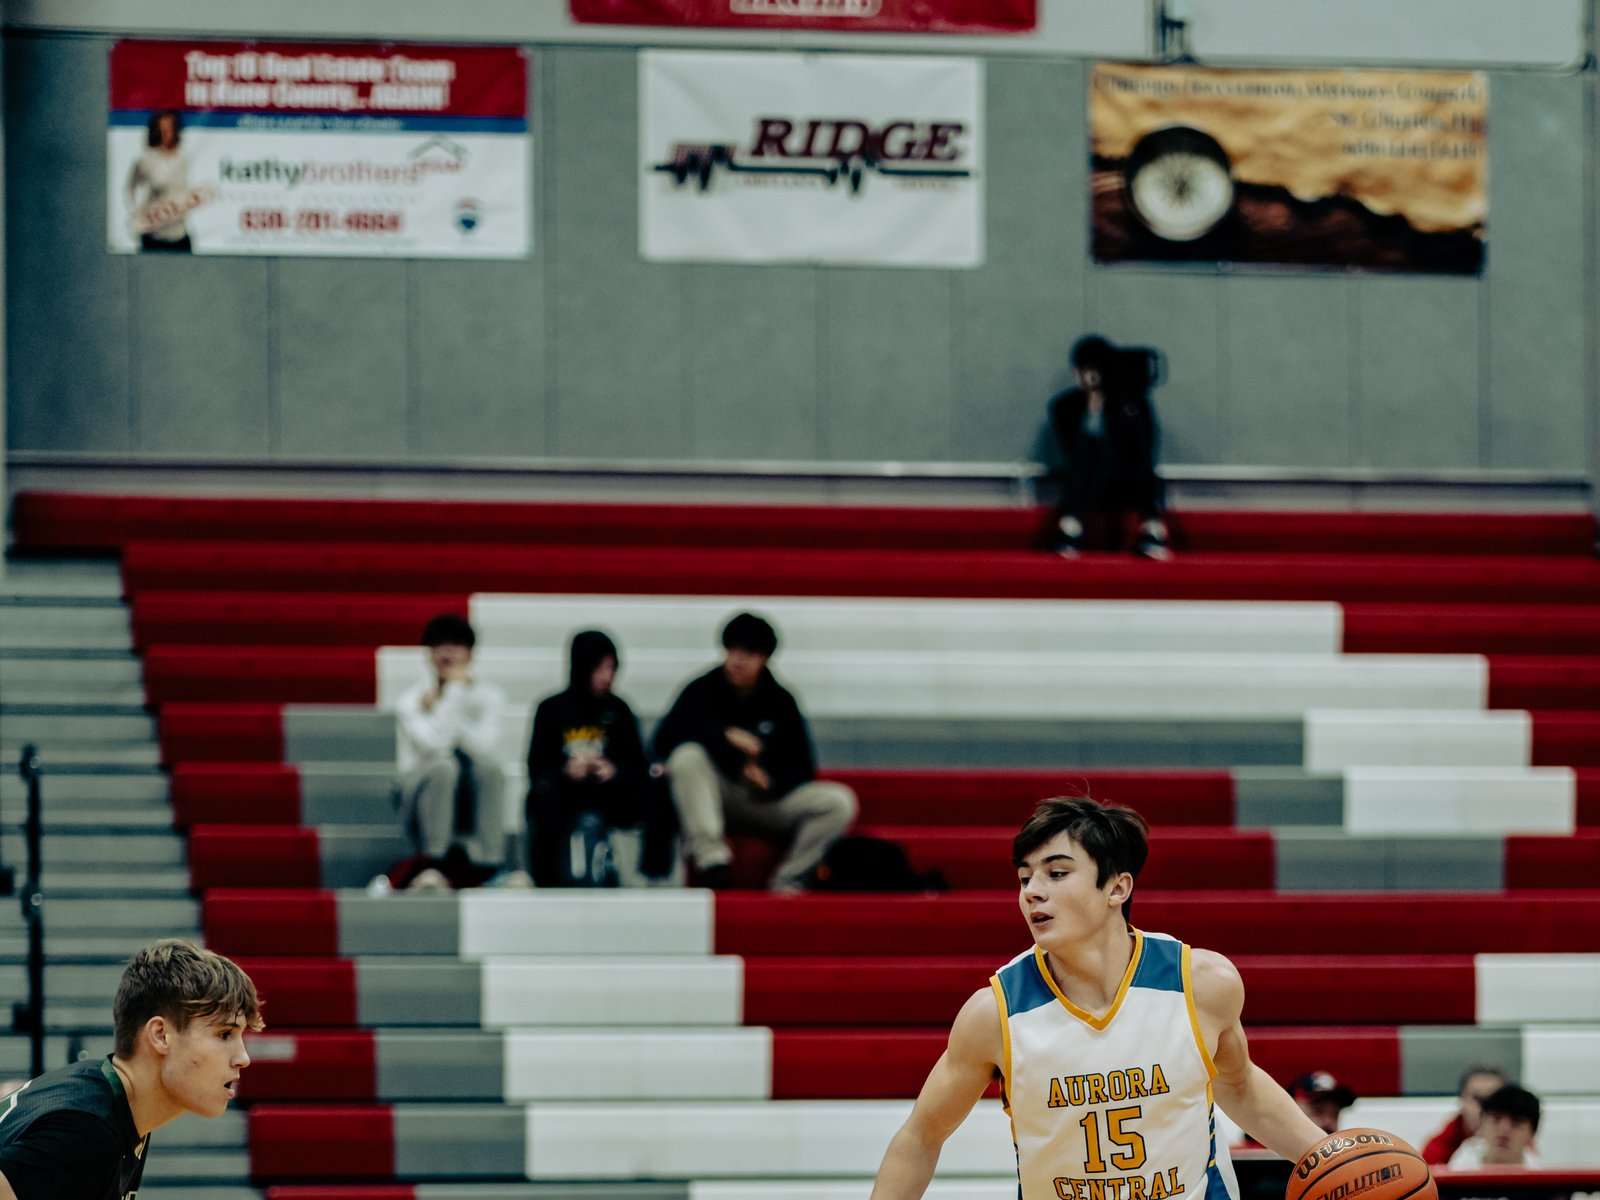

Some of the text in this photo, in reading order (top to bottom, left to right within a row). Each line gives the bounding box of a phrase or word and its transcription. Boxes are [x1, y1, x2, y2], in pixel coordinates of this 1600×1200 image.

[751, 118, 966, 162] RIDGE
[1048, 1064, 1170, 1108] AURORA
[1080, 1105, 1147, 1173] 15
[1296, 1133, 1395, 1181] Wilson
